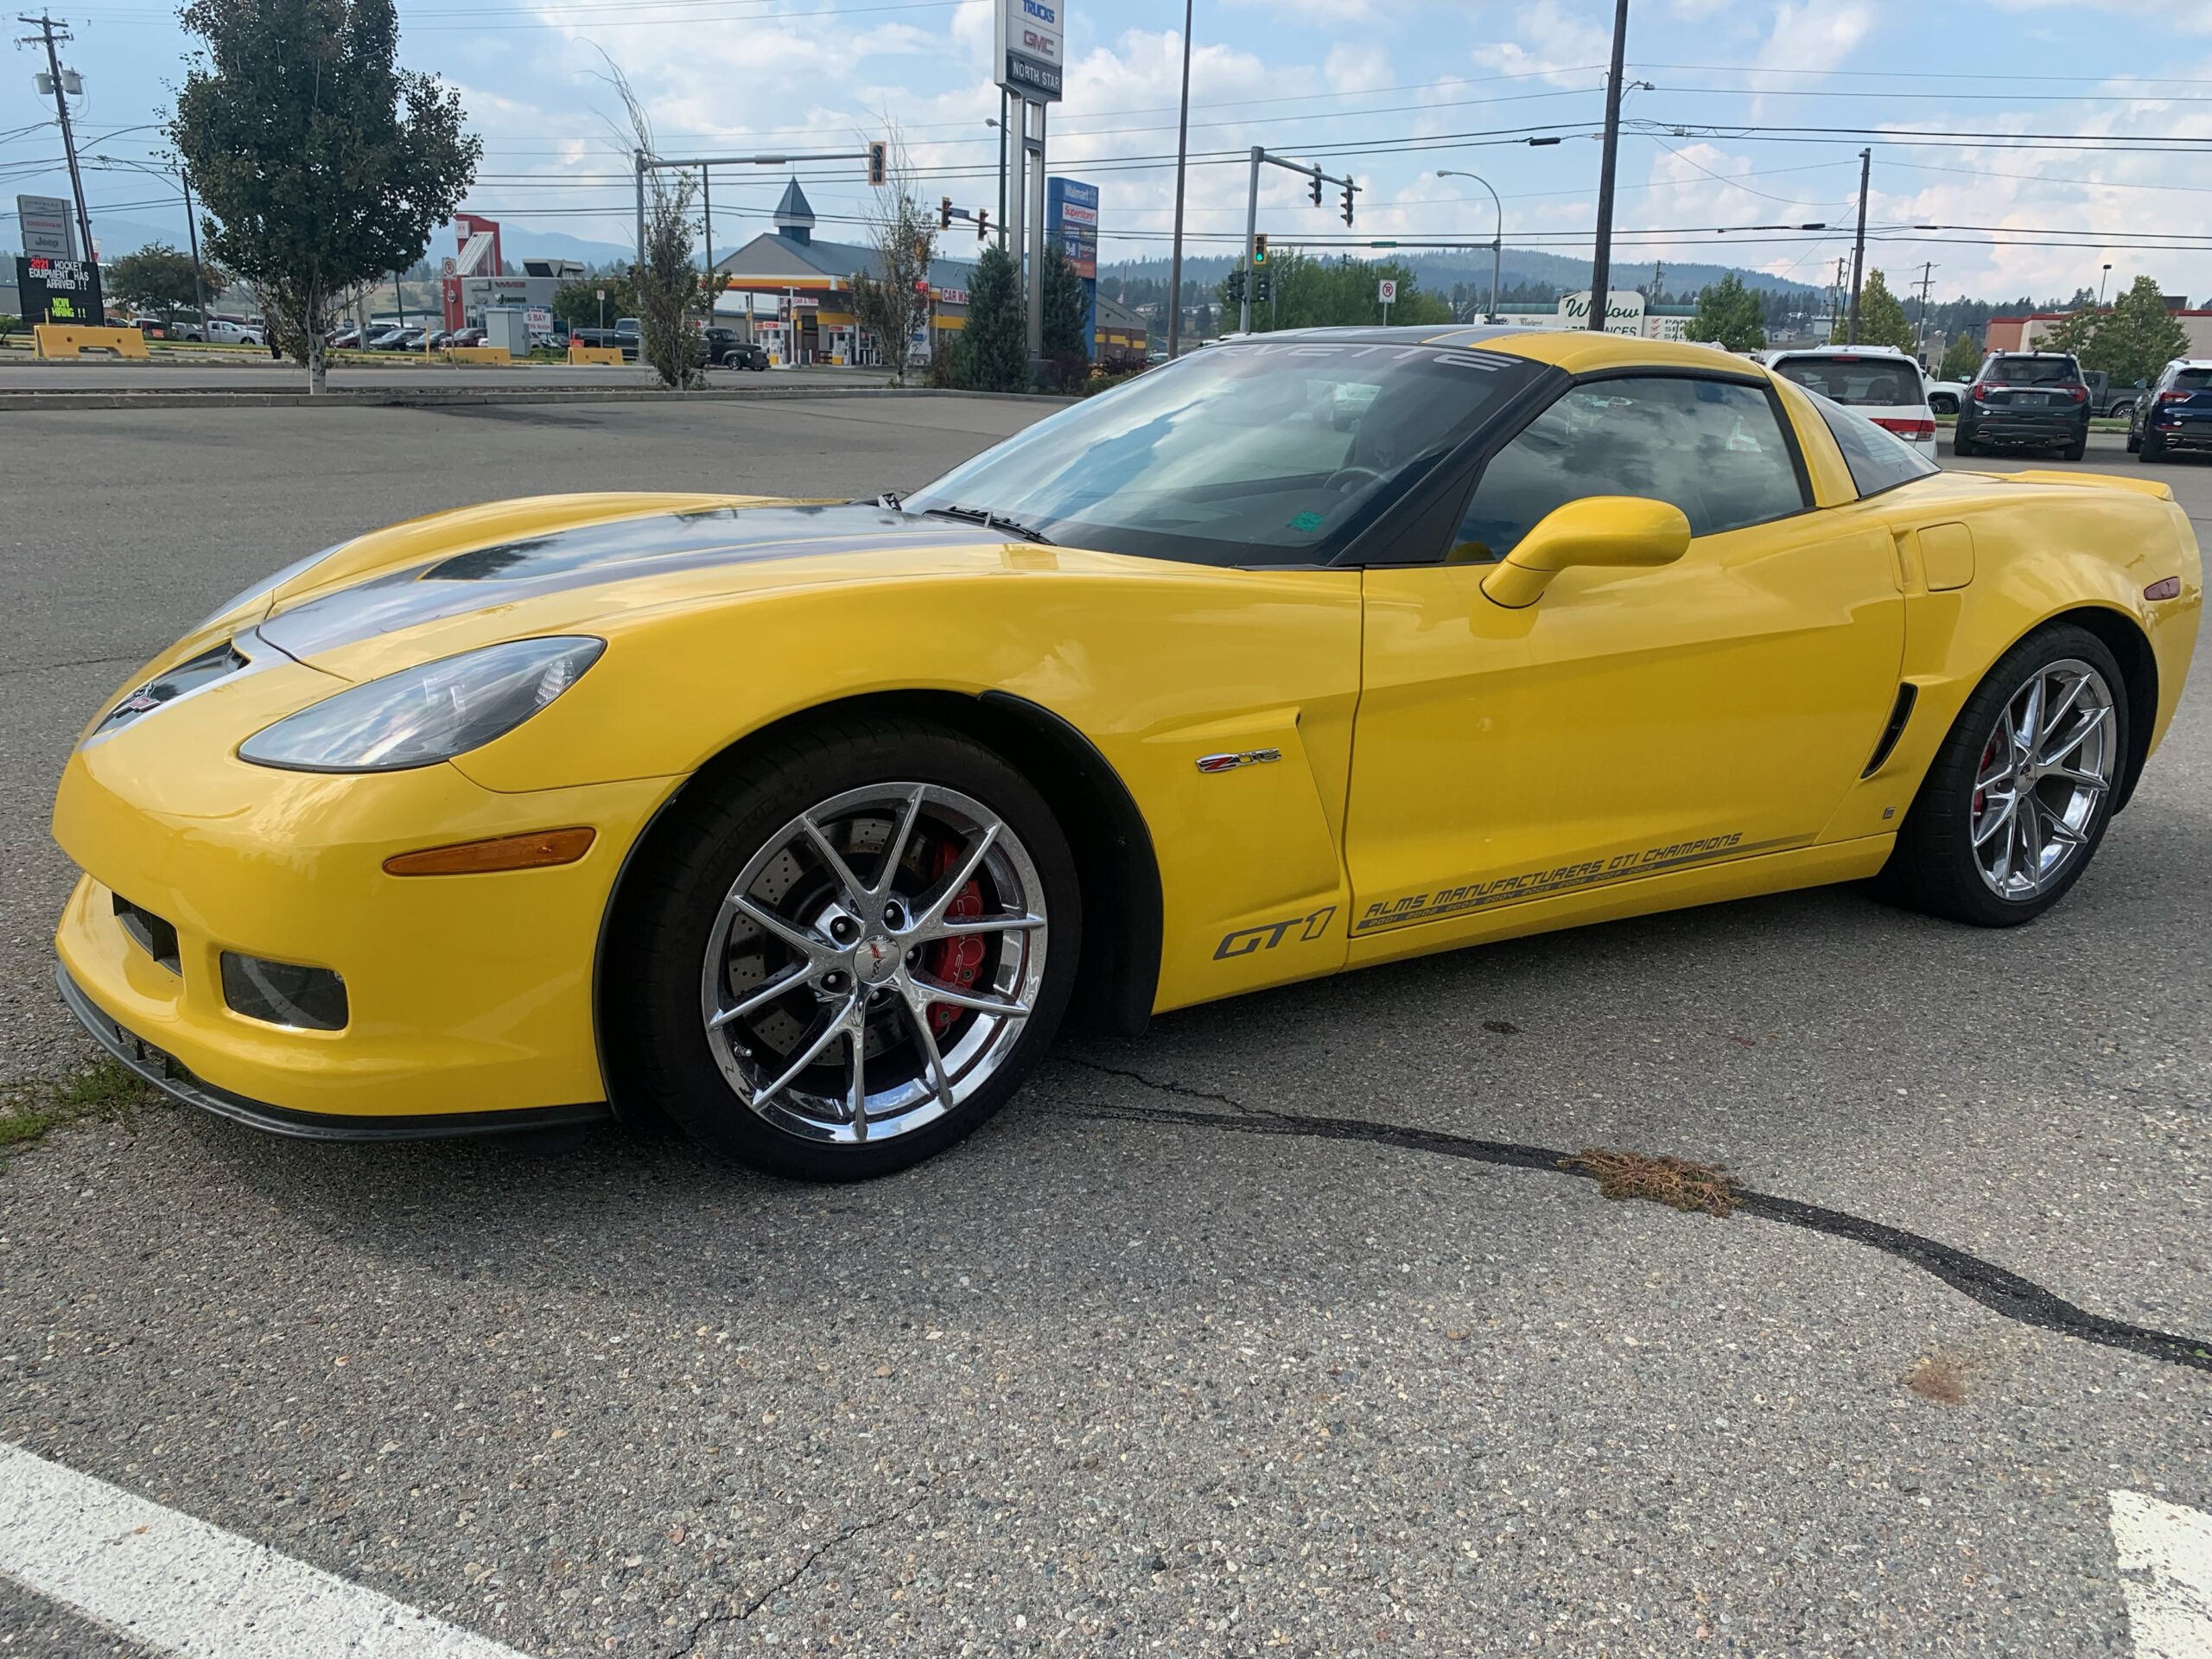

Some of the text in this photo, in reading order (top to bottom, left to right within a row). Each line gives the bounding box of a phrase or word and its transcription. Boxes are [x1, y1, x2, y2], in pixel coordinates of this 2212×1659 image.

[1023, 0, 1054, 23] TRUCKS
[1024, 30, 1054, 57] GMC
[1013, 61, 1060, 90] NORTH STAR
[1065, 183, 1089, 201] Walmart
[1064, 205, 1094, 220] Superstore
[35, 237, 59, 248] Jeep
[30, 259, 82, 270] 2021 HOCKEY
[29, 268, 90, 281] EQUIPMENT HAS
[46, 278, 75, 289] ARRIVED
[52, 297, 69, 308] NOW
[944, 289, 957, 302] CAR
[52, 307, 74, 317] HIRING
[1566, 298, 1640, 318] Wlow
[1364, 893, 1429, 918] ALMS
[1432, 860, 1605, 906] MANUFACTURERS
[1642, 832, 1744, 862] CHAMPIONS
[1368, 916, 1398, 927] 2001
[1406, 908, 1438, 919] 2002
[1445, 900, 1477, 912] 2003
[1484, 893, 1515, 903] 2004
[1521, 885, 1551, 896] 2005
[1213, 906, 1338, 961] GT1
